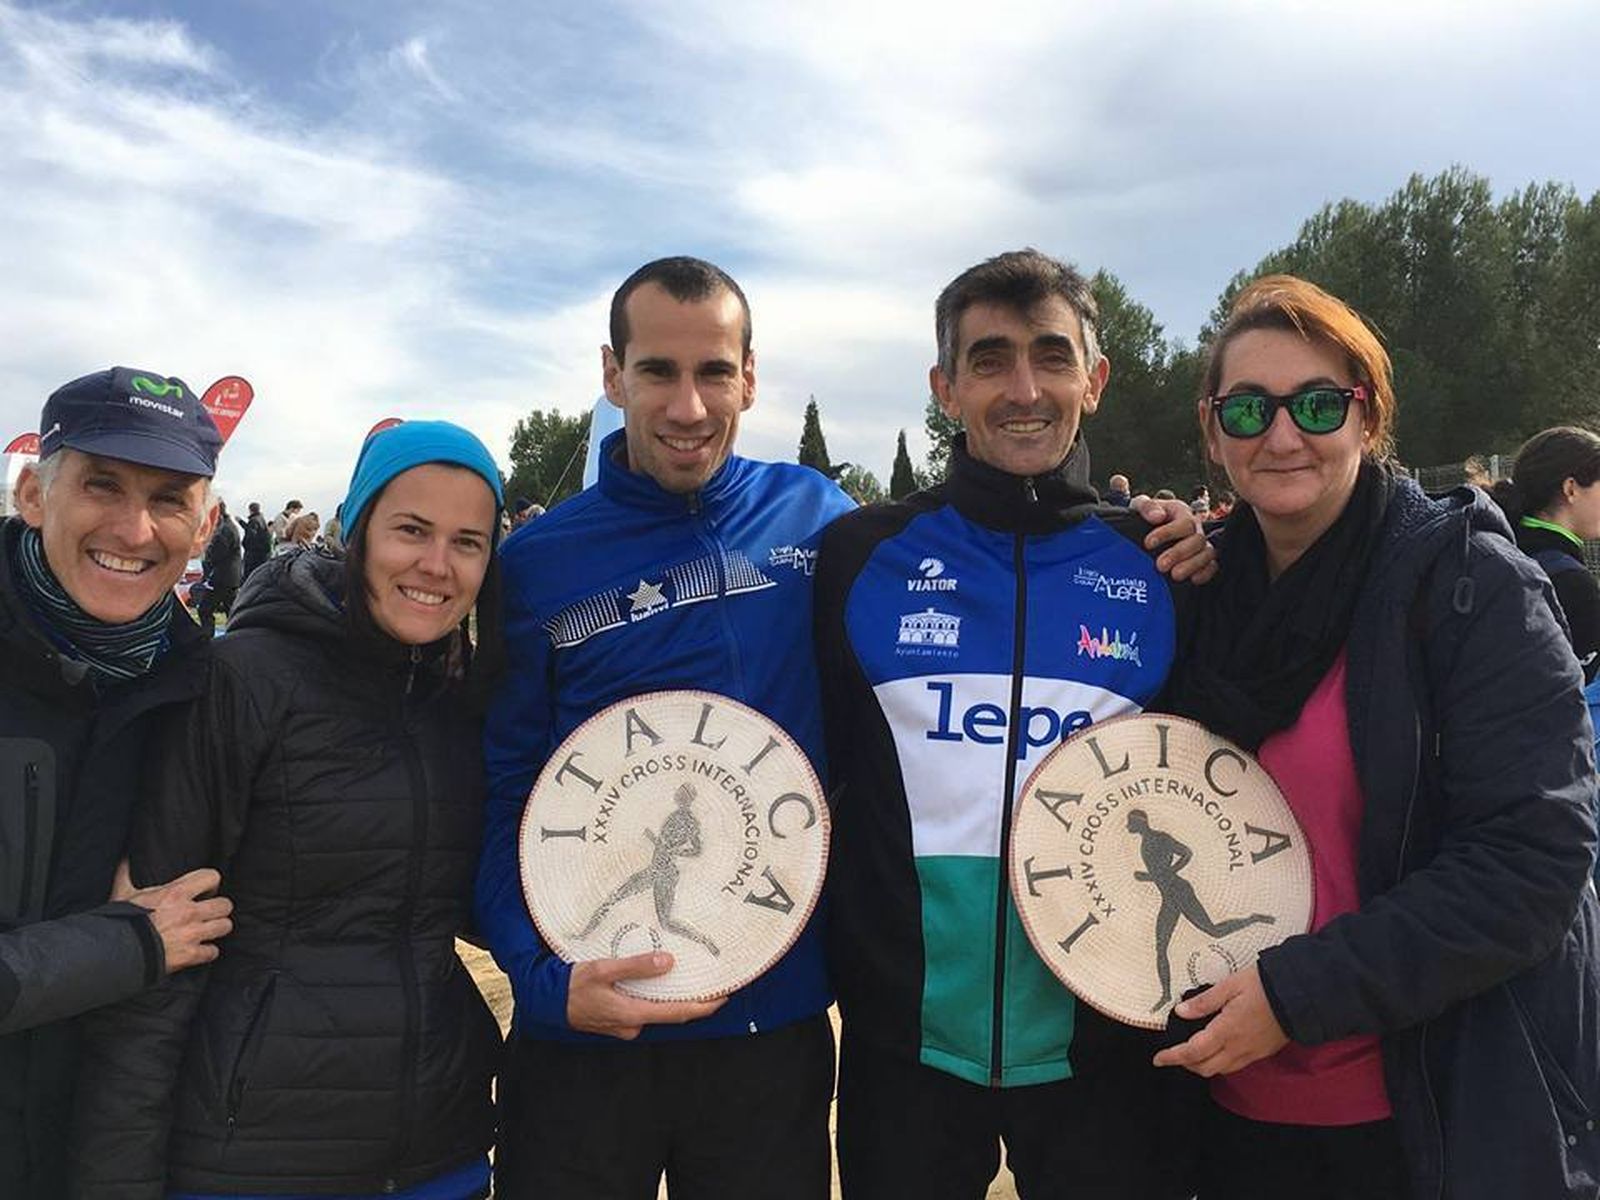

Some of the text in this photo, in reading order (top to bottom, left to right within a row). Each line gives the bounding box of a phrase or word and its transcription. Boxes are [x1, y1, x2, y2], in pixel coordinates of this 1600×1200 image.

[129, 396, 184, 419] movistar
[907, 578, 957, 591] VIATOR
[541, 702, 816, 916] ITALICA
[593, 755, 760, 895] XXXIV CROSS INTERNACIONAL
[1024, 724, 1292, 954] ITALICA
[1079, 778, 1244, 918] XXXIV CROSS INTERNACIONAL
